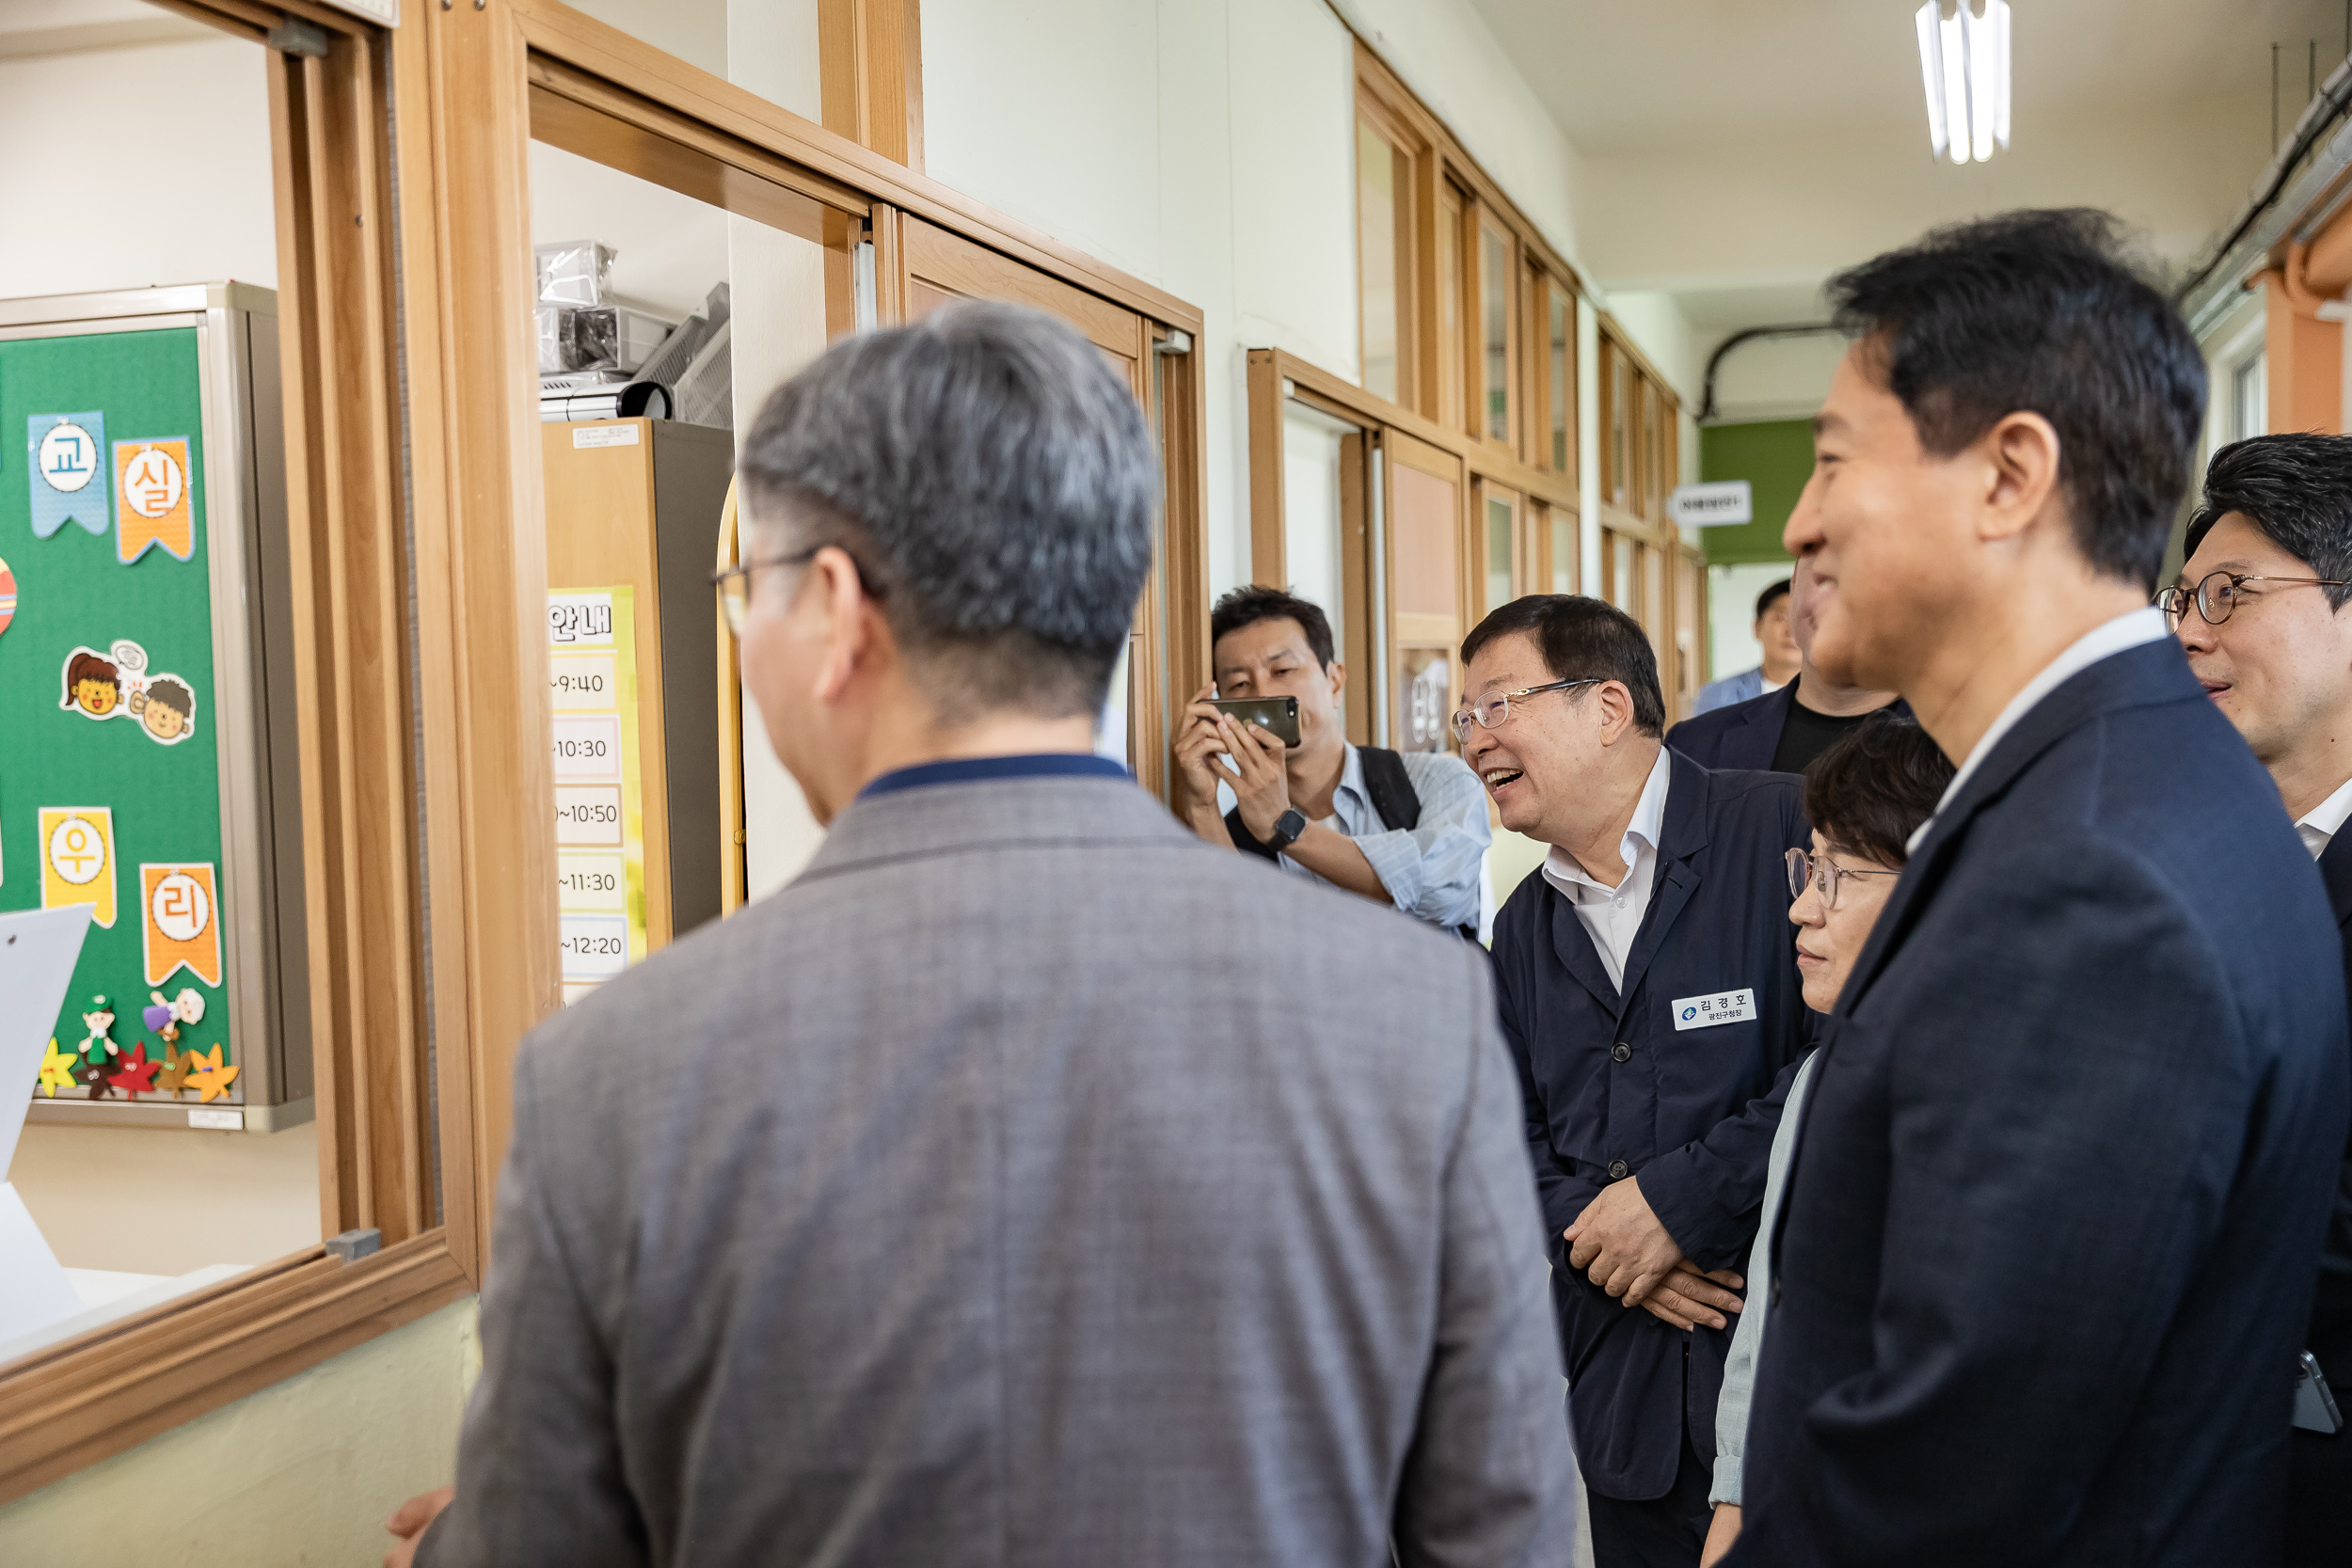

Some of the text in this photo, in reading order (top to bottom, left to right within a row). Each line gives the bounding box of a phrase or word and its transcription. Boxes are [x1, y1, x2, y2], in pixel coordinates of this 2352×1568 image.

[48, 436, 171, 513] 교 실
[548, 605, 612, 641] 안내
[58, 828, 197, 928] 우 리
[1708, 1009, 1742, 1021] 광진구청장
